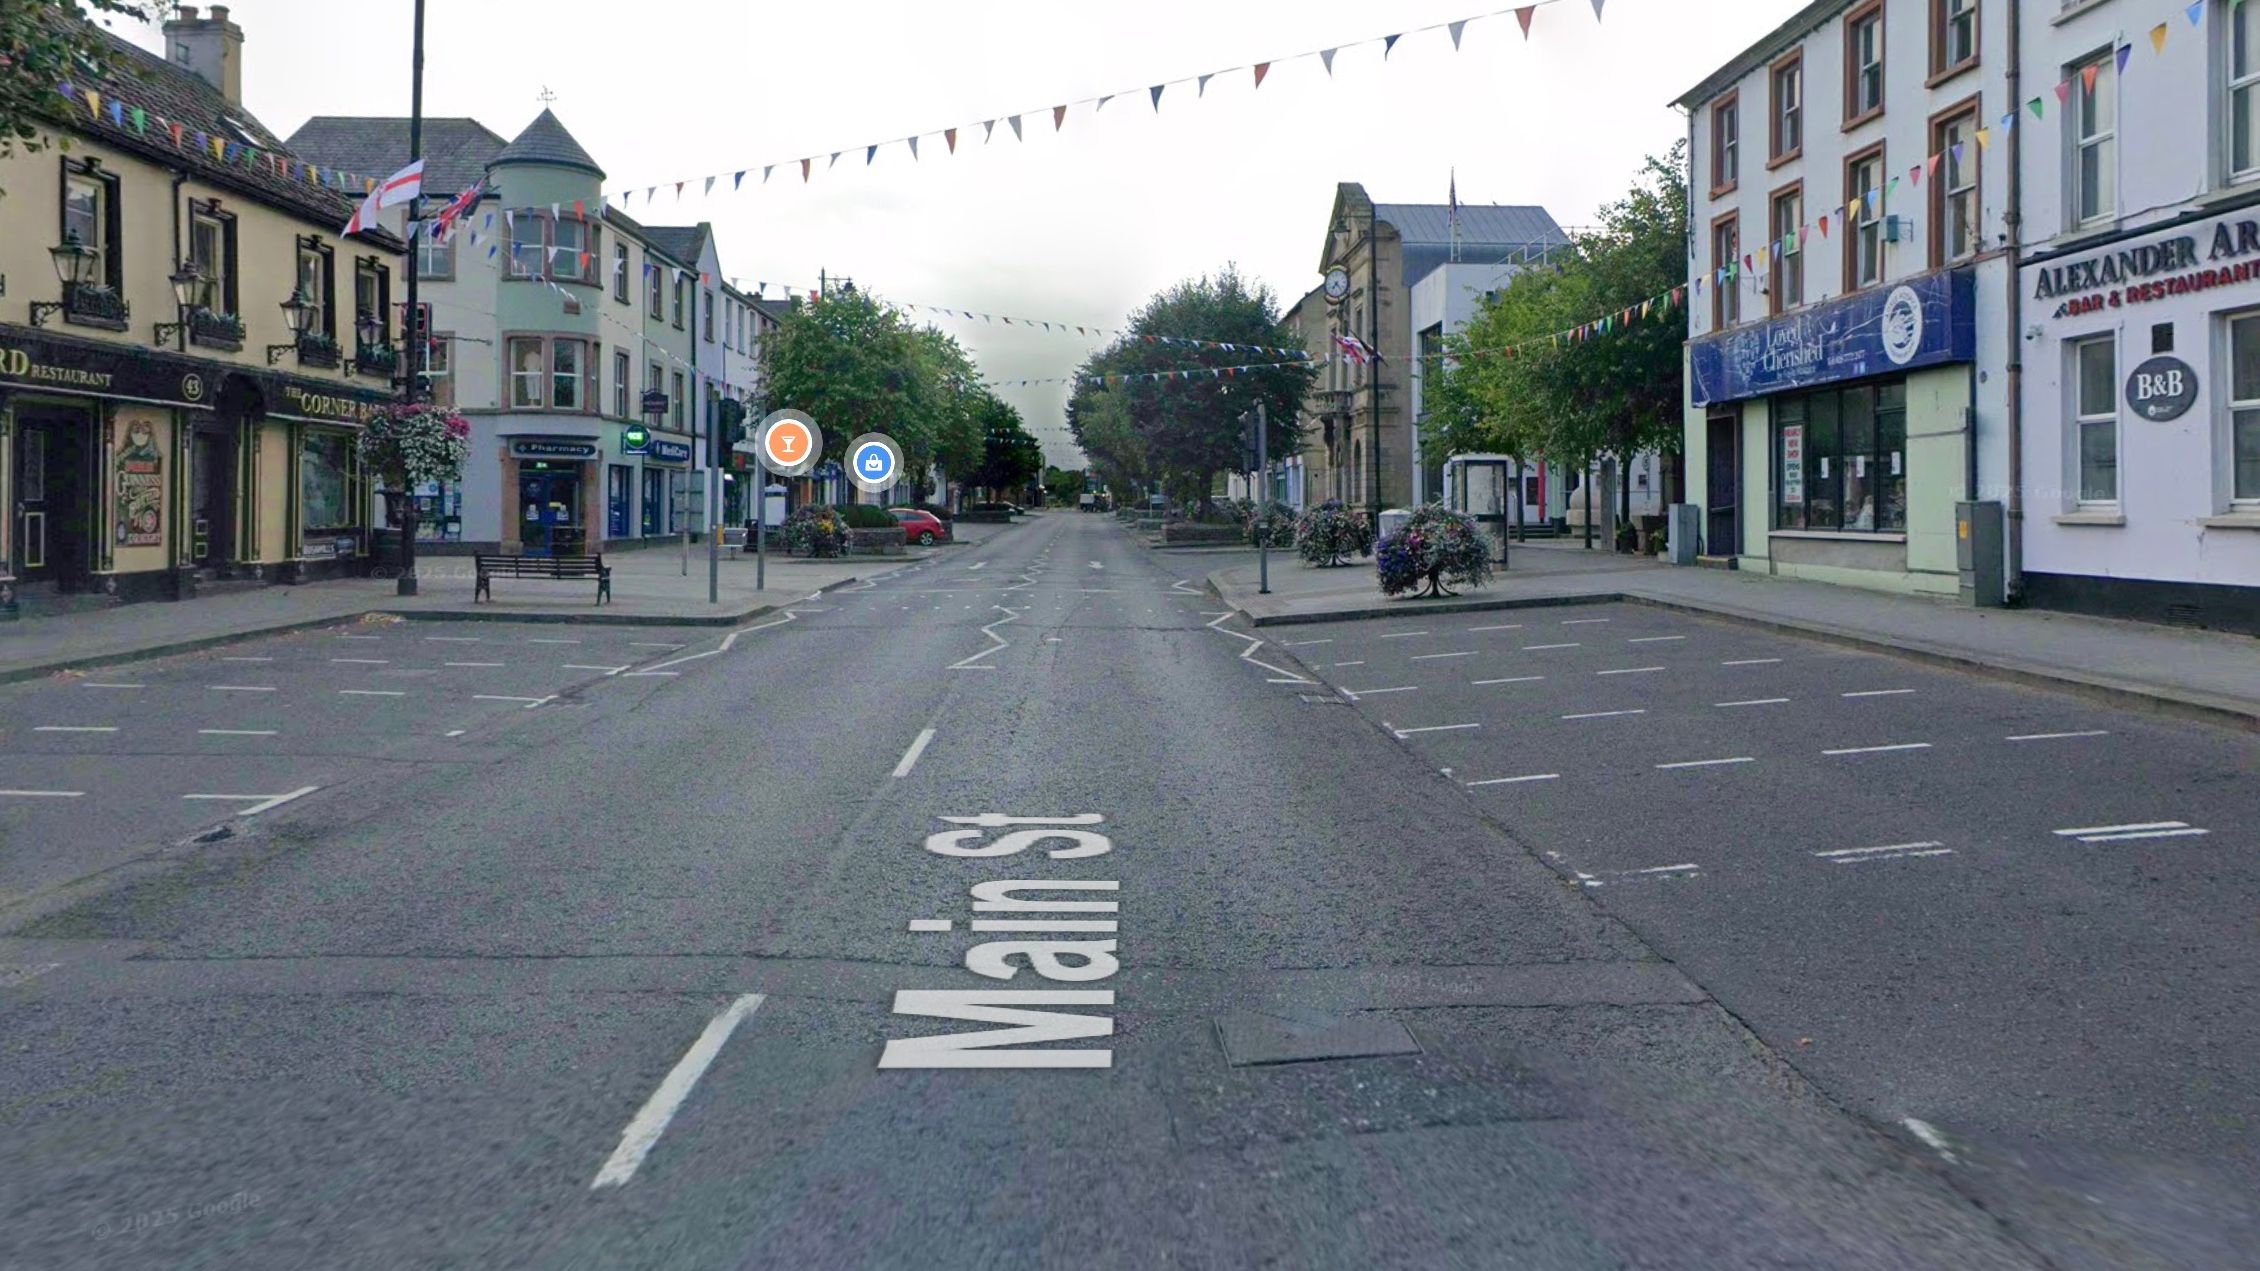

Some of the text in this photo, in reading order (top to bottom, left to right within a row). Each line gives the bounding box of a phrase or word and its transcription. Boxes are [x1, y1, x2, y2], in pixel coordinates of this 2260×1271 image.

[2034, 235, 2198, 299] ALEXANDER
[2068, 258, 2260, 317] BAR & RESTAURANT
[1767, 317, 1801, 348] Loved
[1762, 334, 1823, 373] Cherished
[31, 364, 113, 387] RESTAURANT
[185, 379, 200, 395] 43
[2136, 369, 2184, 401] B&B
[301, 392, 356, 417] CORNER
[530, 443, 590, 455] Pharmacy
